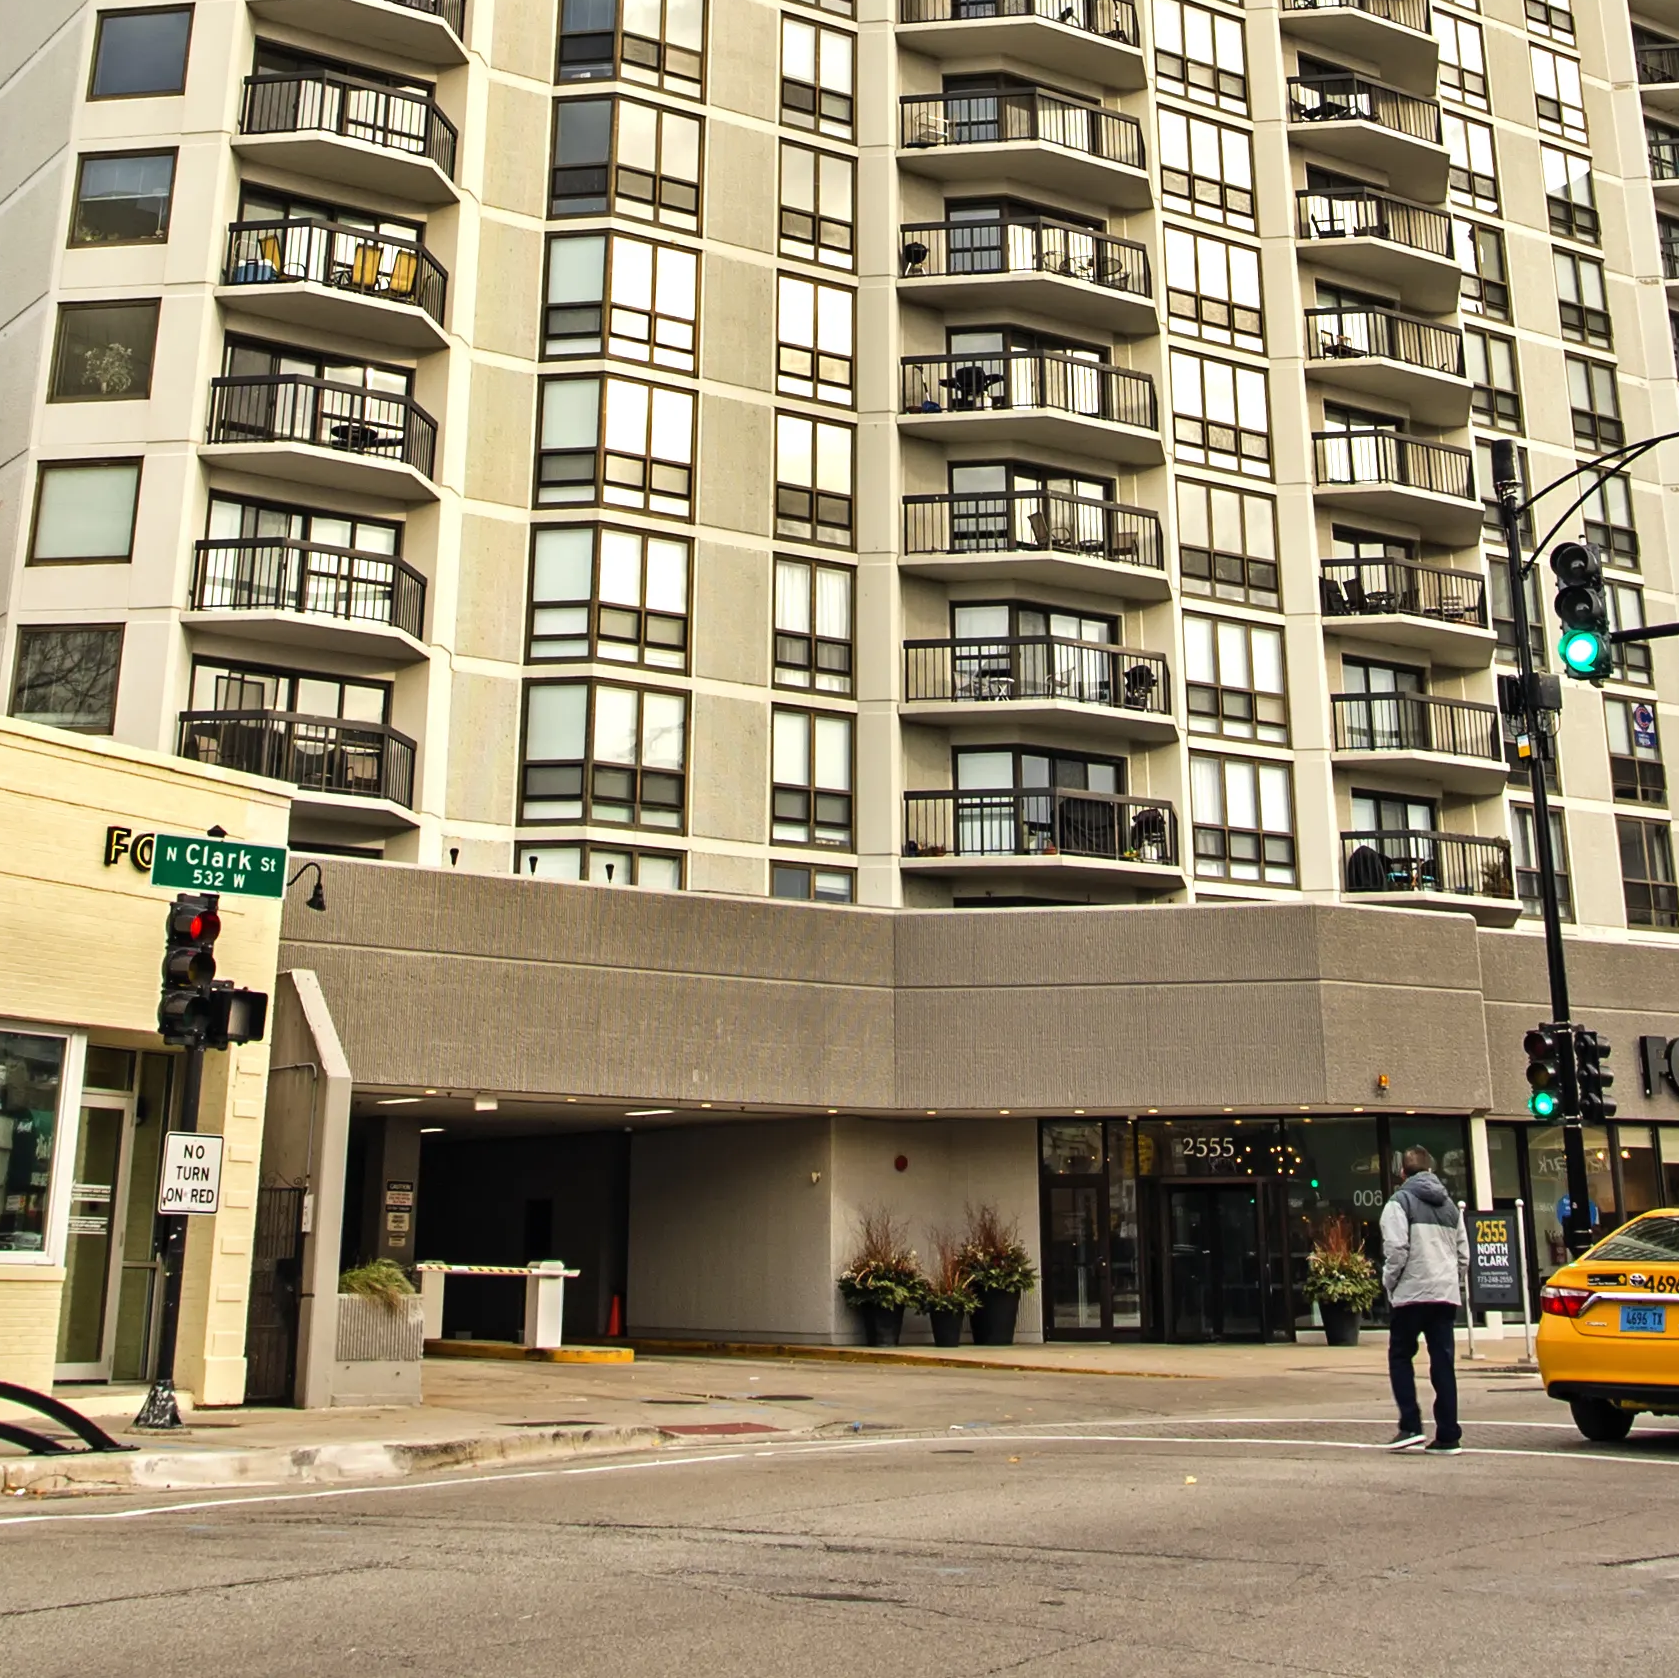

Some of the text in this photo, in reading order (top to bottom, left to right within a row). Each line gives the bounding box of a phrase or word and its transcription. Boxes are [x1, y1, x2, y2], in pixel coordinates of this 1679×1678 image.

[166, 844, 276, 873] N Clark St
[192, 869, 245, 888] 532 W
[183, 1145, 205, 1159] NO
[1182, 1137, 1235, 1158] 2555
[176, 1165, 210, 1182] TURN
[166, 1188, 215, 1204] ON RED
[1476, 1220, 1508, 1243] 2555
[1477, 1243, 1509, 1255] NORTH
[1477, 1255, 1509, 1267] CLARK
[1626, 1311, 1663, 1325] 4696 TX
